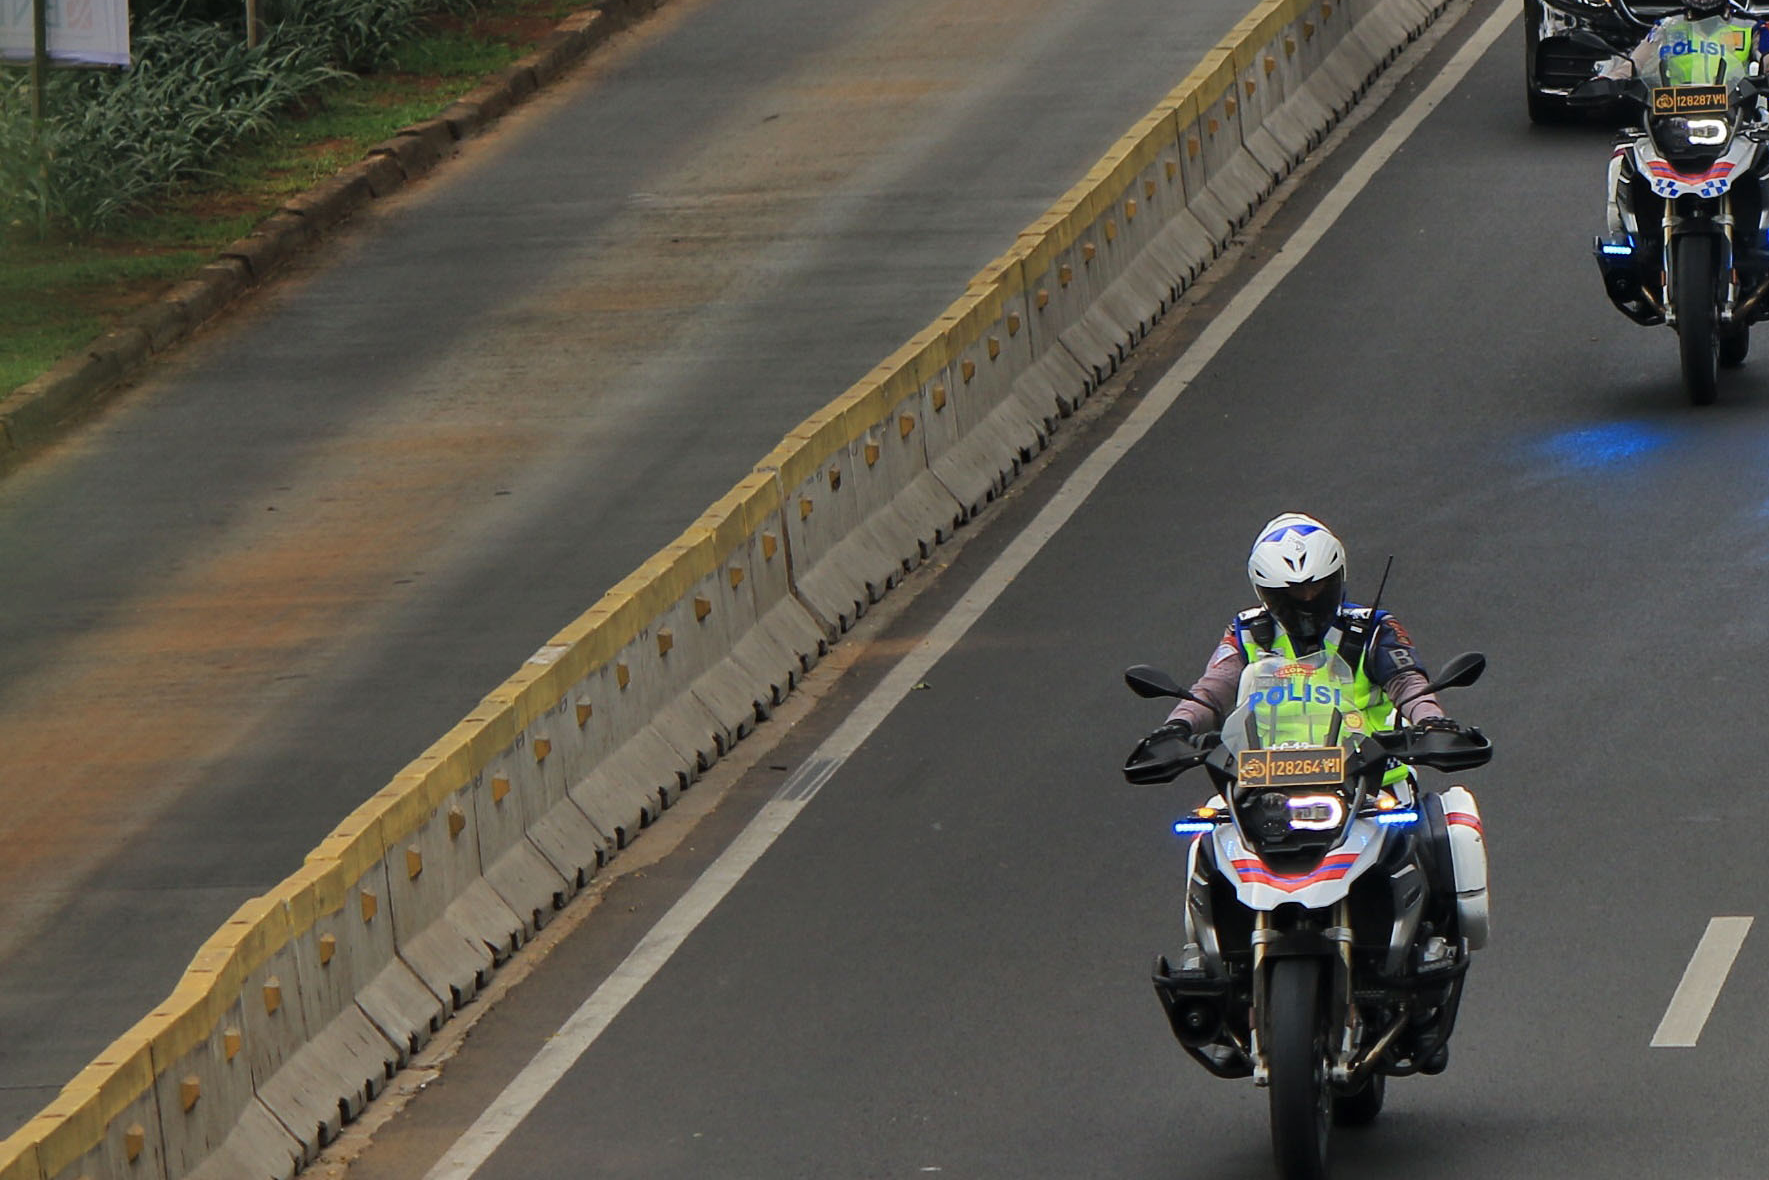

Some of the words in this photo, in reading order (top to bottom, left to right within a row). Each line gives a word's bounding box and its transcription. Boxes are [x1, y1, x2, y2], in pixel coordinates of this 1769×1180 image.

[1659, 40, 1725, 60] POLISI
[1389, 649, 1416, 669] B
[1249, 684, 1341, 711] POLISI
